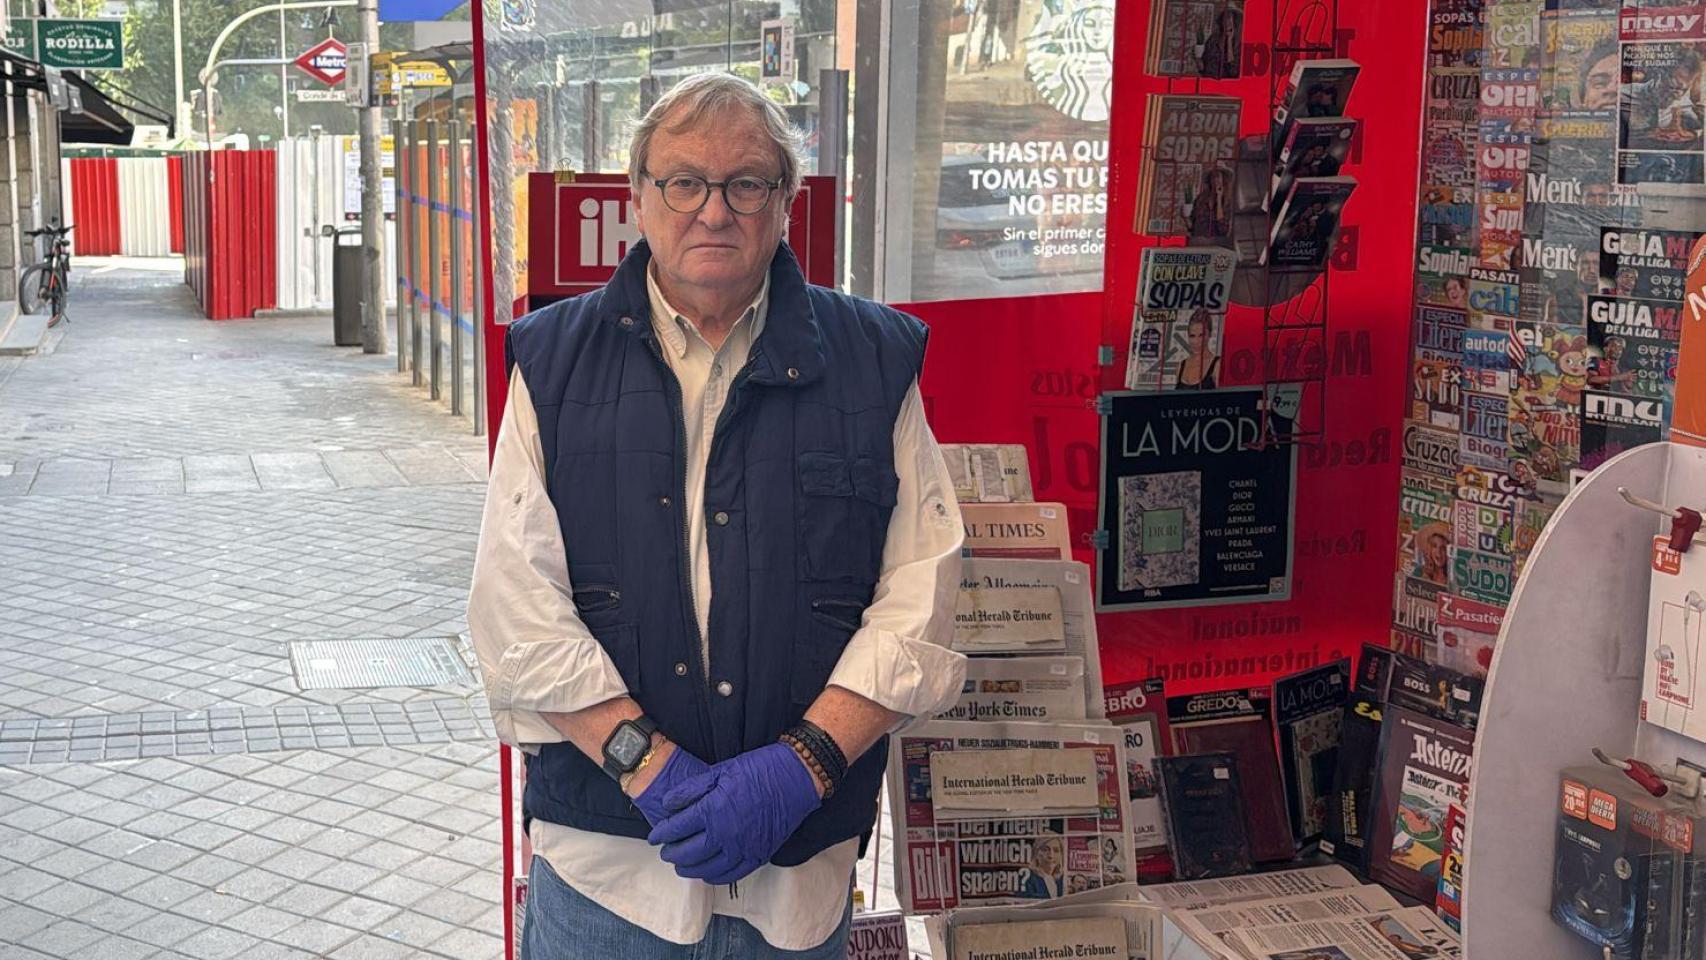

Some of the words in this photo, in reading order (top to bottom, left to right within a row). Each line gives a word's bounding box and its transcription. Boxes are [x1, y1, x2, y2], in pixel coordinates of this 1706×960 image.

[1621, 14, 1701, 32] muy
[45, 37, 115, 50] RODILLA
[988, 141, 1067, 163] HASTA
[1159, 136, 1235, 162] SOPAS
[969, 168, 1058, 190] TOMAS
[1063, 167, 1093, 188] TU
[1008, 195, 1046, 216] NO
[1052, 193, 1108, 215] ERES
[1003, 226, 1025, 241] Sin
[1028, 227, 1041, 240] el
[1044, 226, 1092, 243] primer
[1033, 243, 1078, 258] sigues
[1631, 256, 1645, 267] LA
[1646, 257, 1671, 269] LIGA
[1147, 281, 1225, 310] SOPAS
[1591, 301, 1653, 328] GUÍA
[1605, 324, 1619, 334] DE
[1620, 325, 1633, 336] LA
[1634, 327, 1660, 339] LIGA
[1161, 409, 1221, 418] LEYENDAS
[1226, 406, 1241, 415] DE
[1122, 421, 1160, 458] LA
[985, 523, 1046, 539] TIMES
[978, 610, 1012, 623] Herald
[1013, 609, 1053, 622] Tribune
[1403, 677, 1432, 694] BOSS
[968, 702, 1000, 721] York
[1002, 700, 1047, 718] Times
[943, 775, 1010, 789] International
[1011, 774, 1045, 788] Herald
[1046, 773, 1087, 786] Tribune
[961, 838, 1033, 865] wirklich
[912, 847, 950, 901] Bild
[961, 867, 1031, 896] sparen?
[1037, 946, 1074, 960] Herald
[1075, 944, 1116, 958] Tribune
